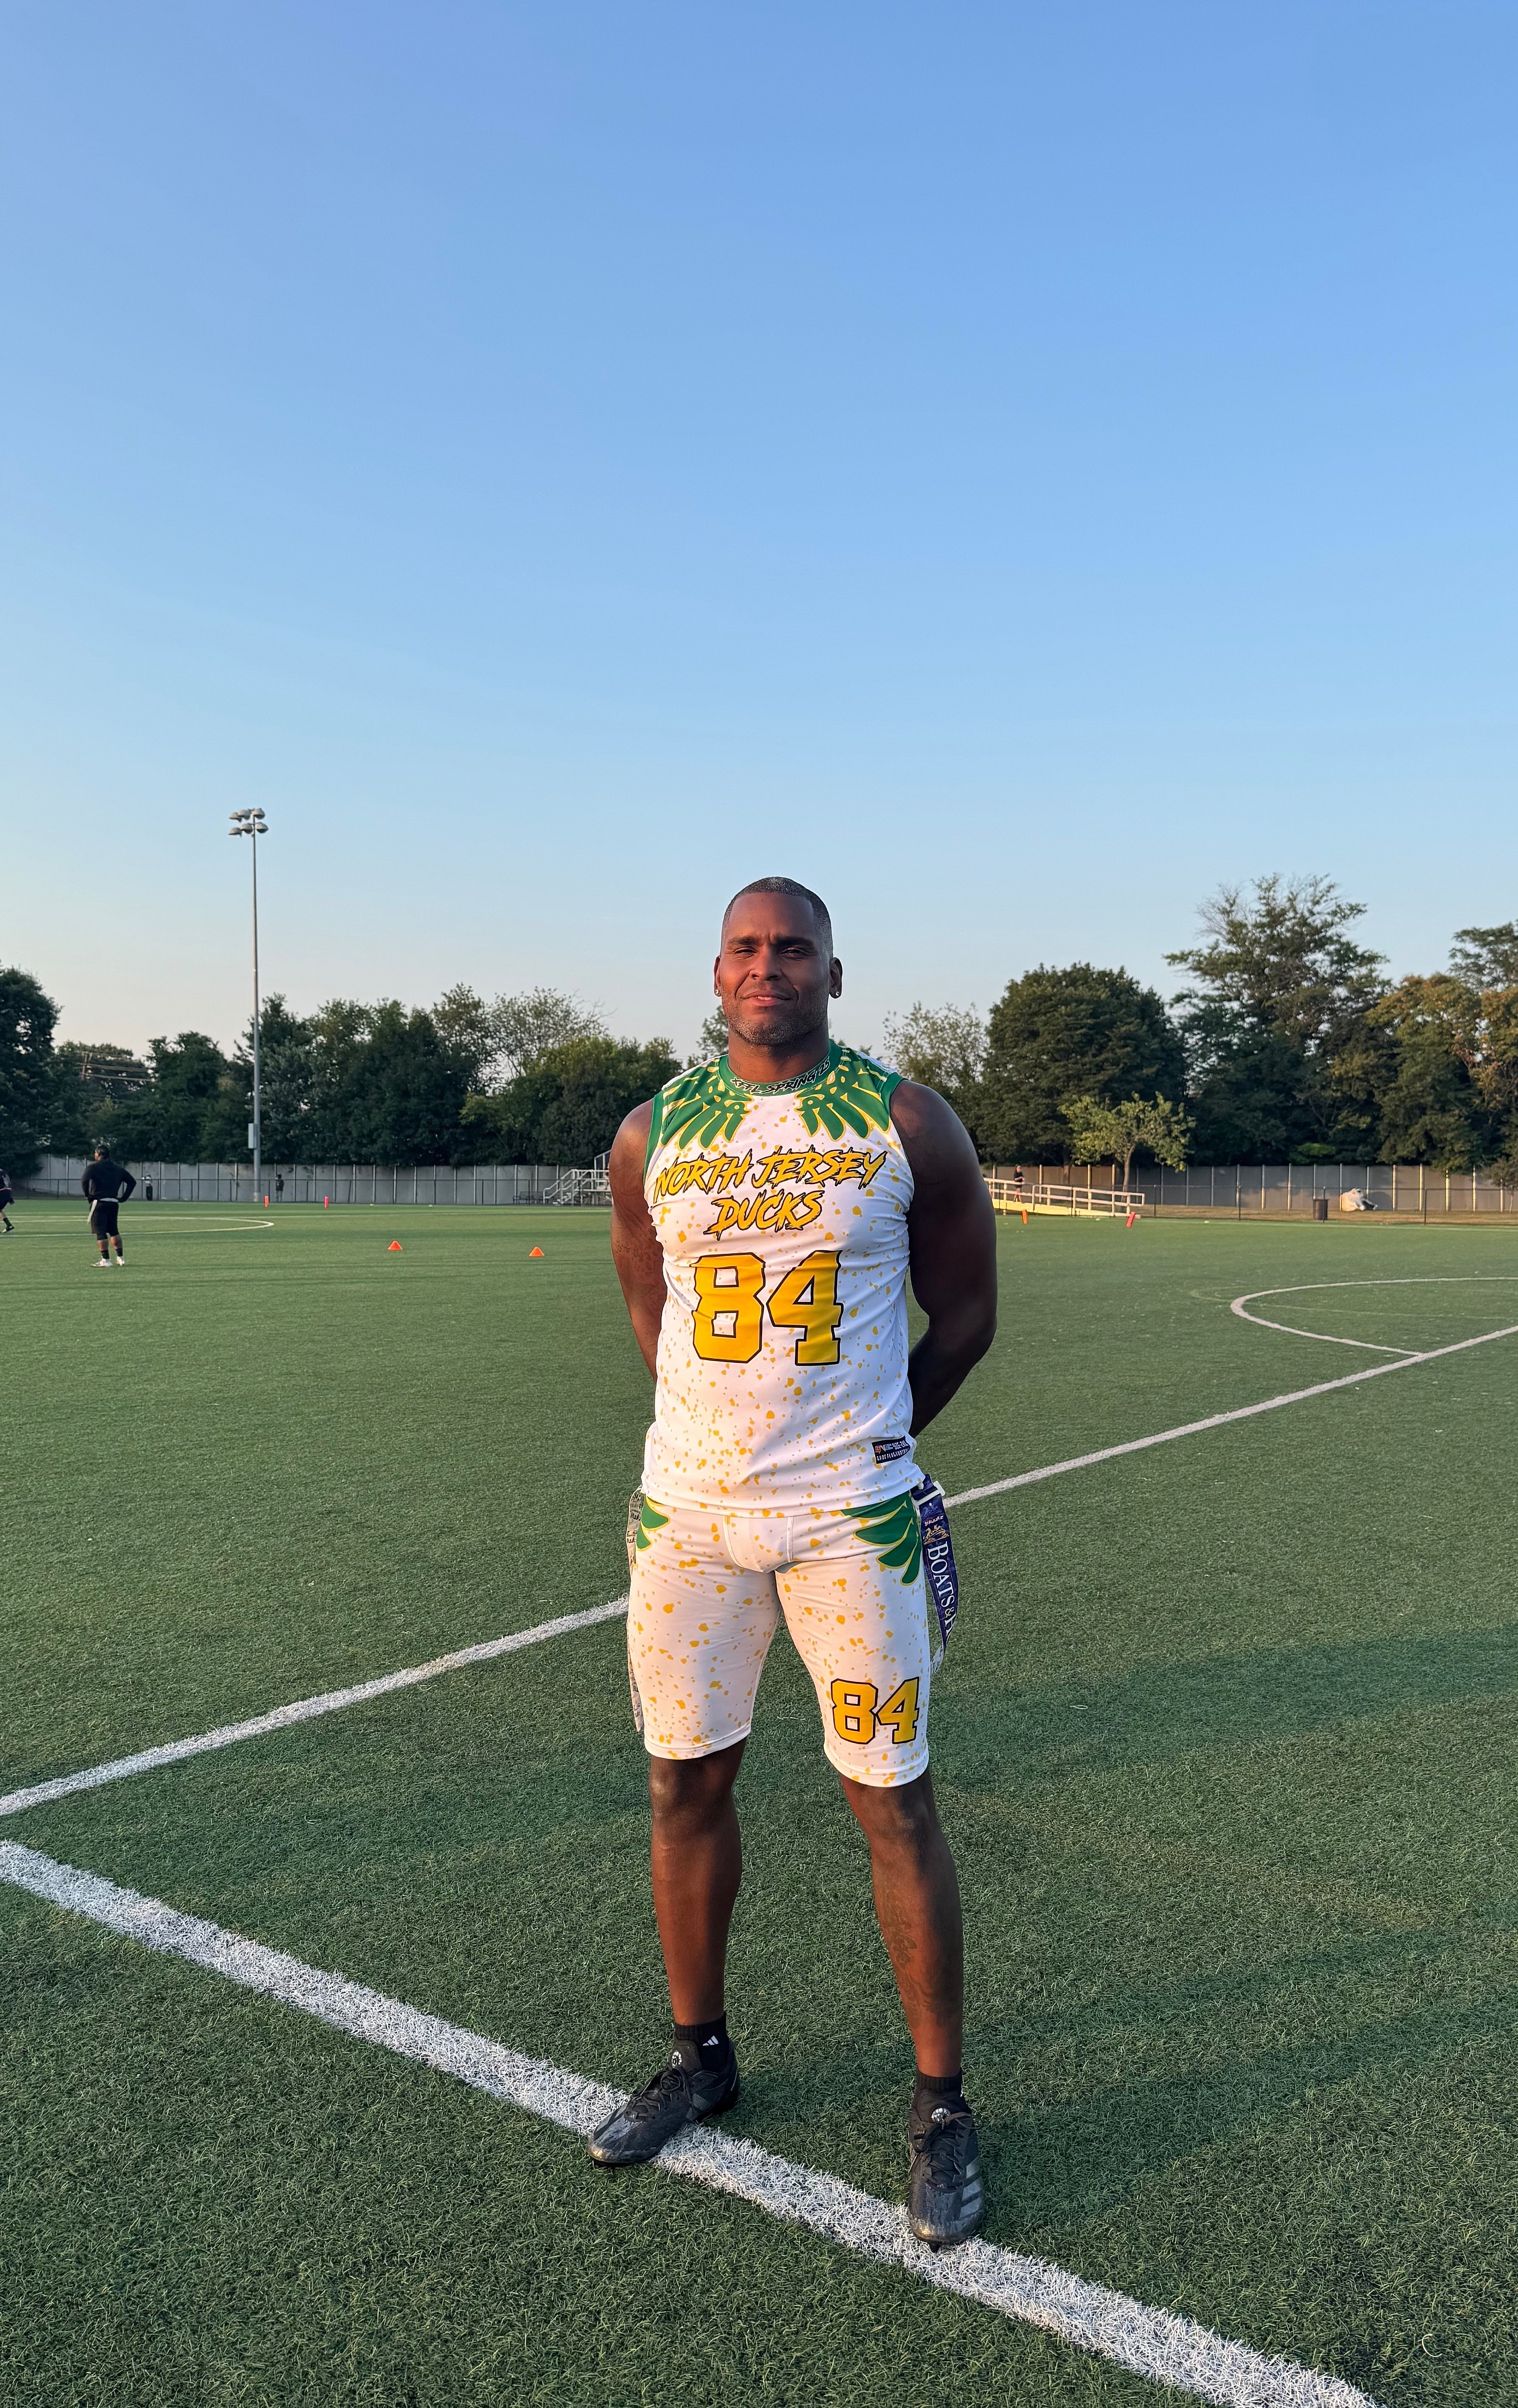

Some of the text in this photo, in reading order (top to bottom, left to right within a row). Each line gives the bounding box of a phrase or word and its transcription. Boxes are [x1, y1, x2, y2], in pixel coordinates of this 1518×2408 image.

[760, 1070, 817, 1094] SPRING
[654, 1145, 887, 1203] NORTH JERSEY
[703, 1189, 825, 1240] DUCKS
[690, 1249, 844, 1366] 84
[831, 1677, 920, 1744] 84
